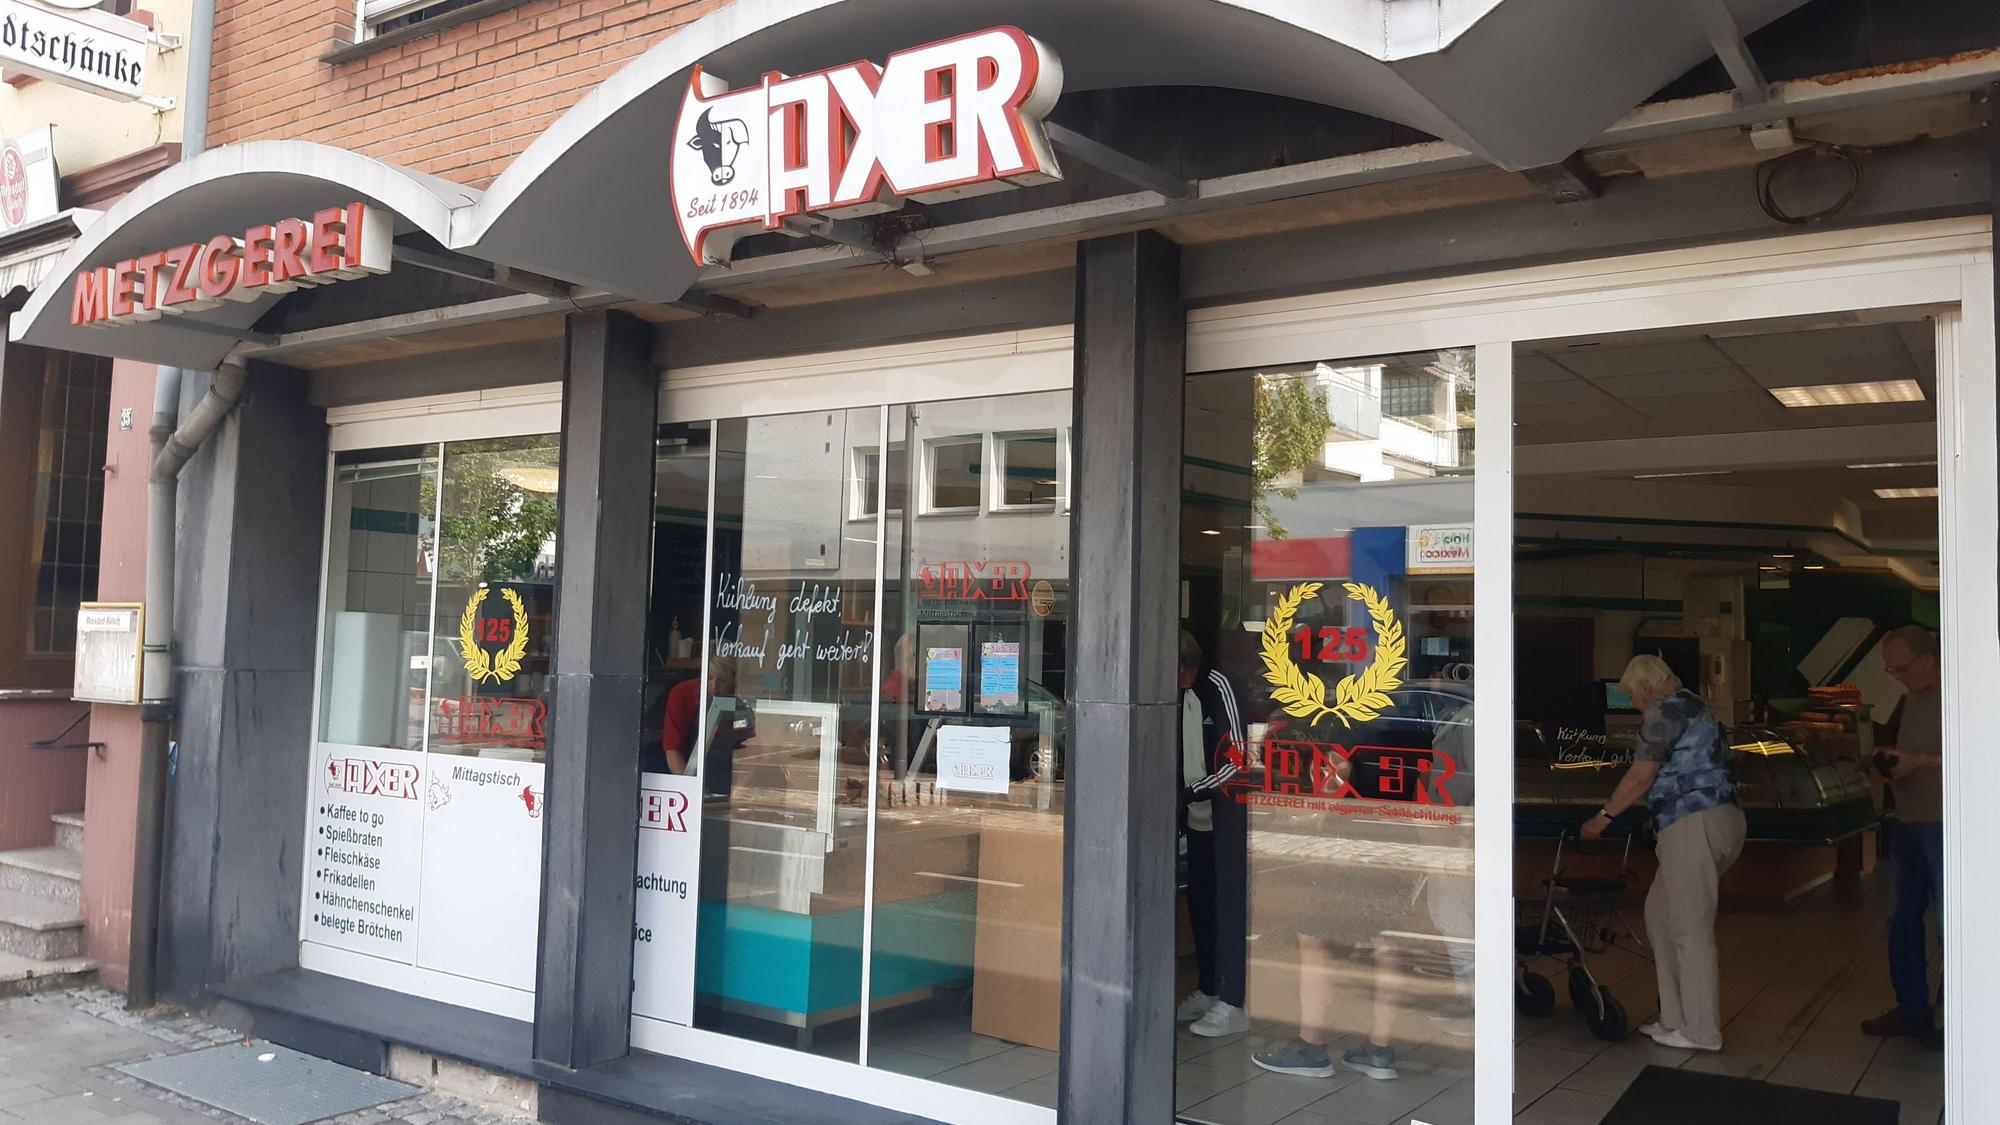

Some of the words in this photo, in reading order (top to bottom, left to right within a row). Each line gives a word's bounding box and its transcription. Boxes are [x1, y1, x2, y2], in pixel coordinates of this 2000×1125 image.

[765, 24, 1042, 217] AXER
[687, 196, 717, 219] Seit
[721, 189, 759, 213] 1894
[71, 202, 365, 326] METZGEREI
[716, 572, 777, 623] Kühlung
[477, 617, 511, 642] 125
[1293, 625, 1369, 662] 125
[715, 621, 770, 668] Verkauf
[777, 629, 811, 670] geht
[1557, 726, 1606, 745] Kühlung
[1264, 739, 1457, 807] AXER
[1611, 748, 1633, 768] geh
[344, 758, 420, 801] AXER
[452, 765, 521, 787] Mittagstisch
[327, 803, 357, 822] Kaffee
[360, 808, 369, 823] to
[371, 812, 384, 828] go
[1235, 793, 1306, 809] METZGEREI
[1307, 801, 1327, 812] mit
[1377, 806, 1458, 826] Schlachtung
[325, 825, 383, 848] Spießbraten
[324, 847, 381, 870] Fleischkäse
[323, 869, 376, 892] Frikadellen
[322, 890, 415, 921] Hähnchenschenkel
[321, 912, 355, 933] belegte
[358, 918, 403, 943] Brötchen
